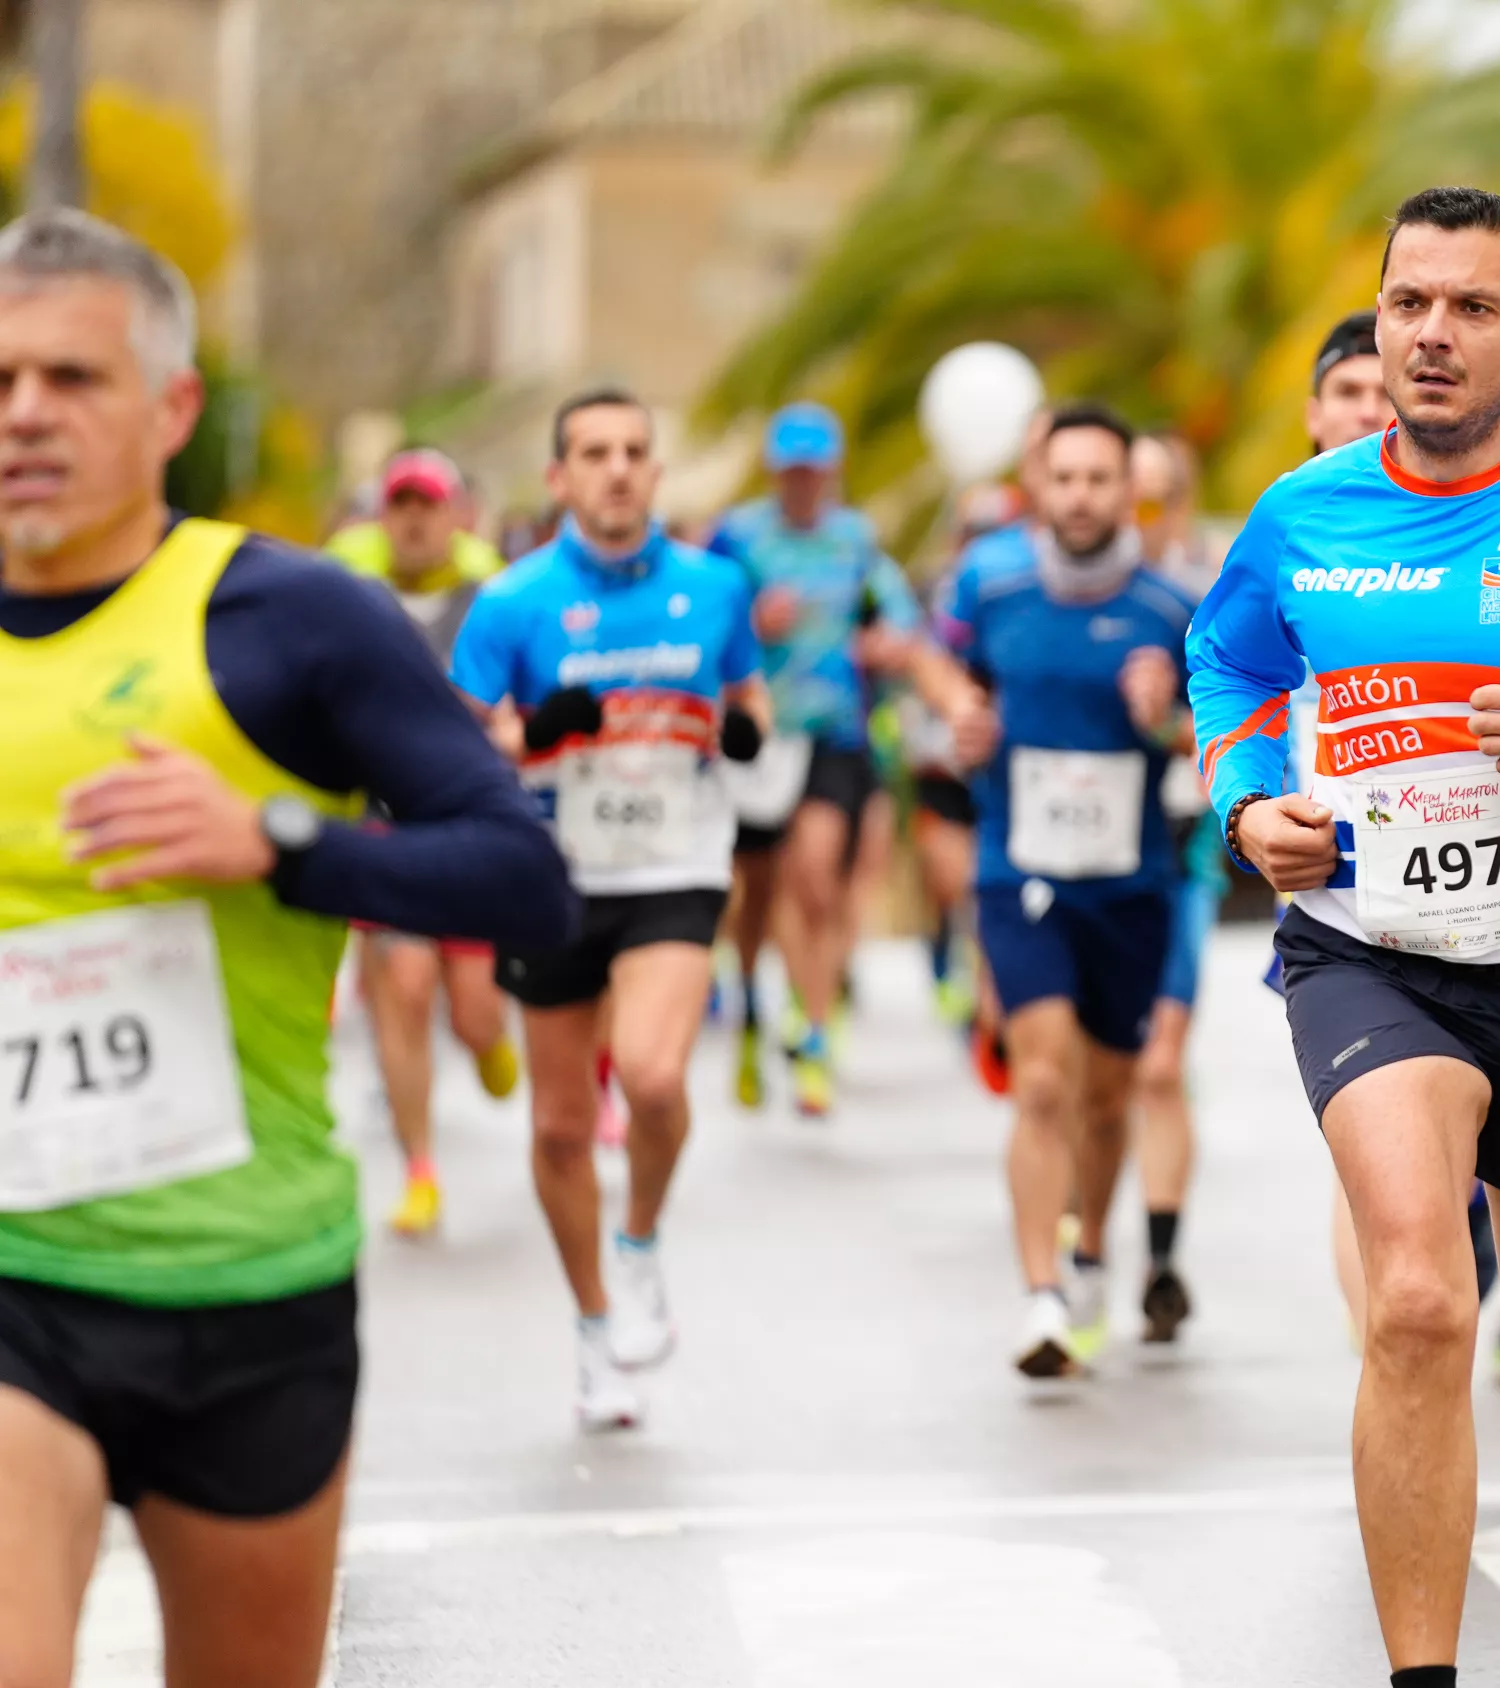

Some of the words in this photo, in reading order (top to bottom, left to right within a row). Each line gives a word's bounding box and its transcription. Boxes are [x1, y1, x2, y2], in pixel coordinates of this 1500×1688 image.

[1292, 562, 1446, 598] enerplus
[1333, 725, 1424, 771] Lucena
[1423, 803, 1490, 824] LUCENA
[1418, 909, 1444, 918] RAFAEL
[1445, 905, 1475, 915] LOZANO
[2, 1014, 153, 1105] 719
